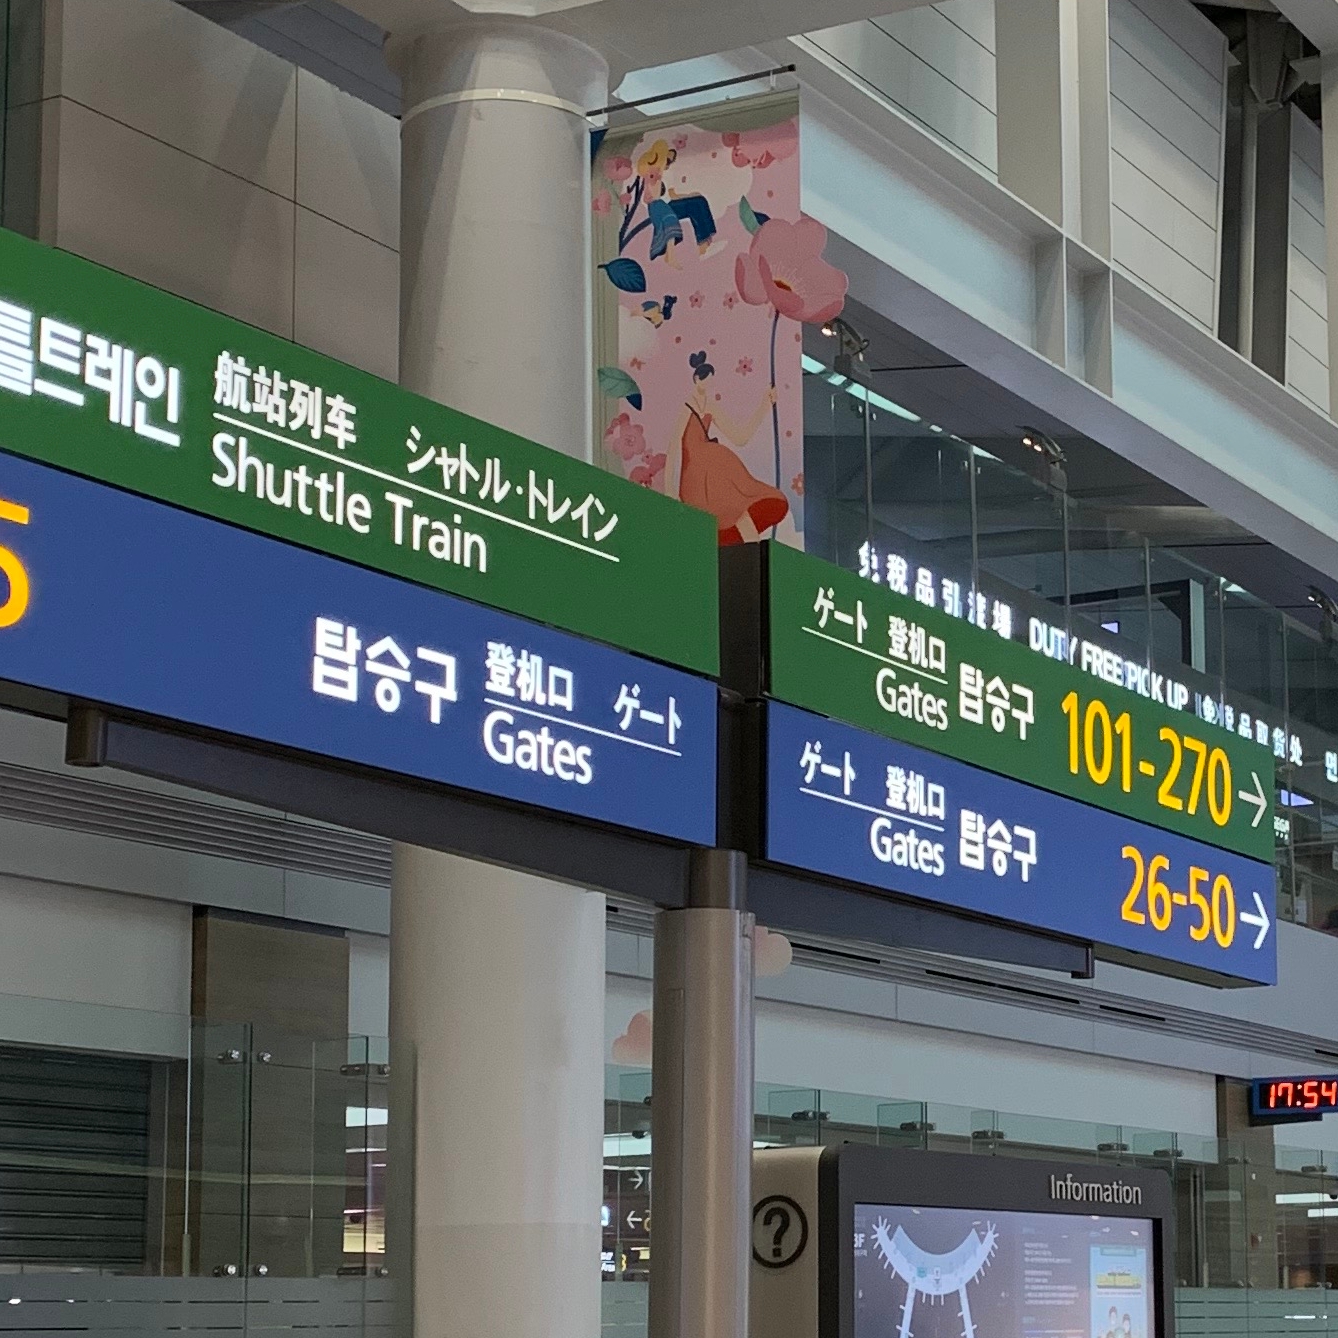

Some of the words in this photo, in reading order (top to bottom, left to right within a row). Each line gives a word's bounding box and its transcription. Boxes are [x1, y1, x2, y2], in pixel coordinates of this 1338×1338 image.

[213, 350, 357, 449] 航站列车
[212, 432, 372, 535] Shuttle
[384, 491, 488, 573] Train
[812, 586, 869, 645] ゲート
[887, 615, 947, 674] 登机口
[312, 615, 458, 725] 탑승구
[484, 641, 574, 712] 登机口
[876, 667, 950, 732] Gates
[1029, 616, 1078, 667] DUTY
[1081, 640, 1127, 688] FREE
[1127, 660, 1166, 704] PICK
[1166, 679, 1189, 712] UP
[612, 682, 683, 743] ゲート
[959, 662, 1036, 741] 탑승구
[482, 710, 593, 785] Gates
[799, 740, 857, 796] ゲート
[1061, 691, 1233, 826] 101-270
[885, 765, 946, 821] 登机口
[870, 816, 946, 877] Gates
[959, 808, 1038, 883] 탑승구
[1121, 845, 1236, 948] 26-50
[1269, 1081, 1338, 1109] 17:54
[1050, 1173, 1142, 1206] Information
